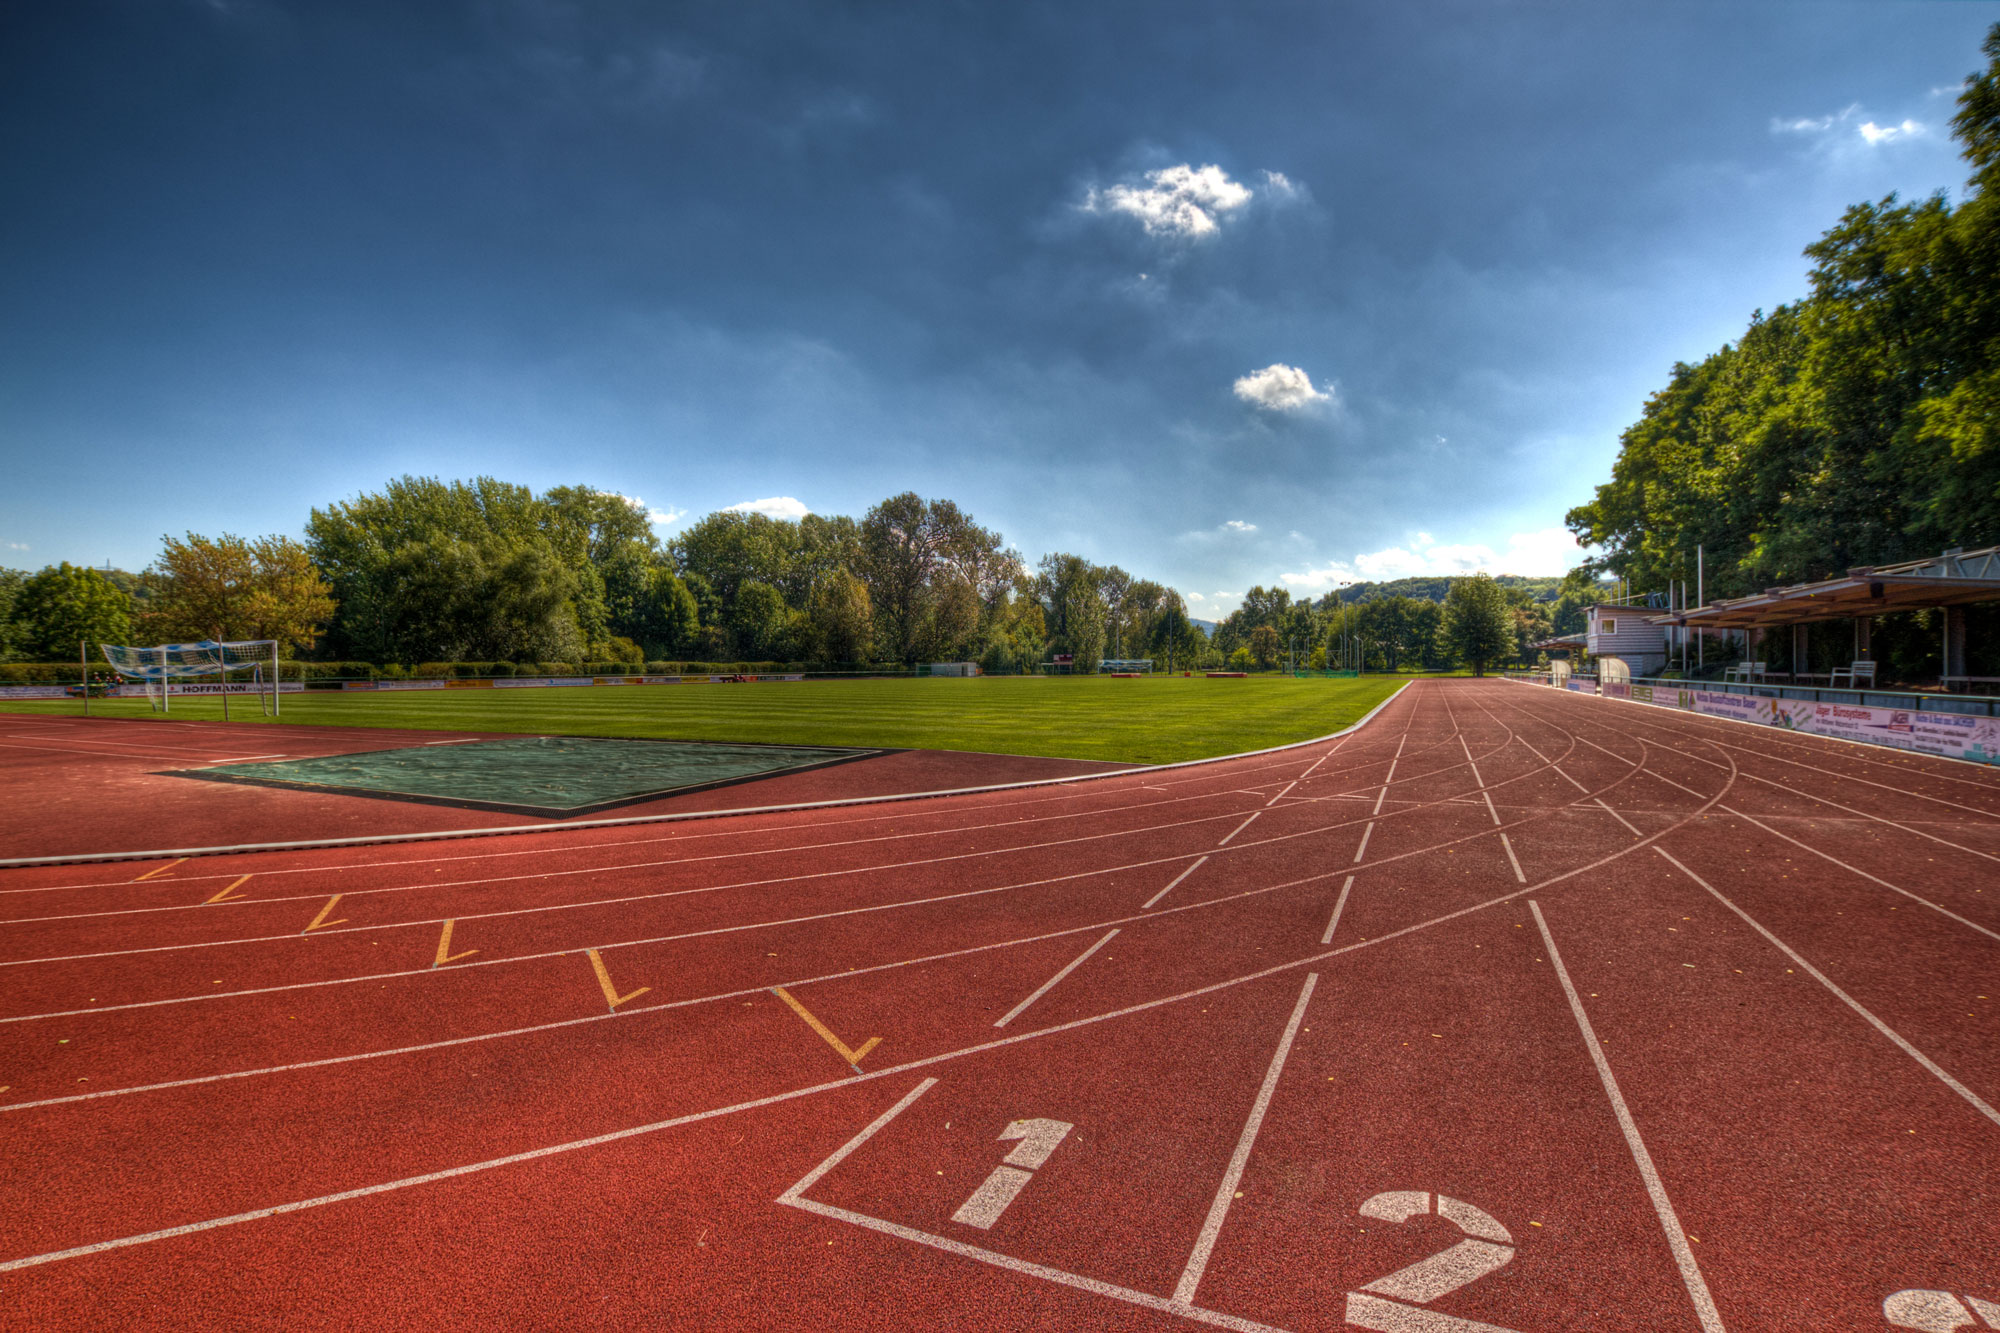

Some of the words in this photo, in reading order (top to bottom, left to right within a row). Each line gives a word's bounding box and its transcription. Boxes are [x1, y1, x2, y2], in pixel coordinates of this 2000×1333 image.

[183, 685, 246, 693] HOFFMANN
[951, 1118, 1074, 1230] 1
[1346, 1191, 1520, 1333] 2
